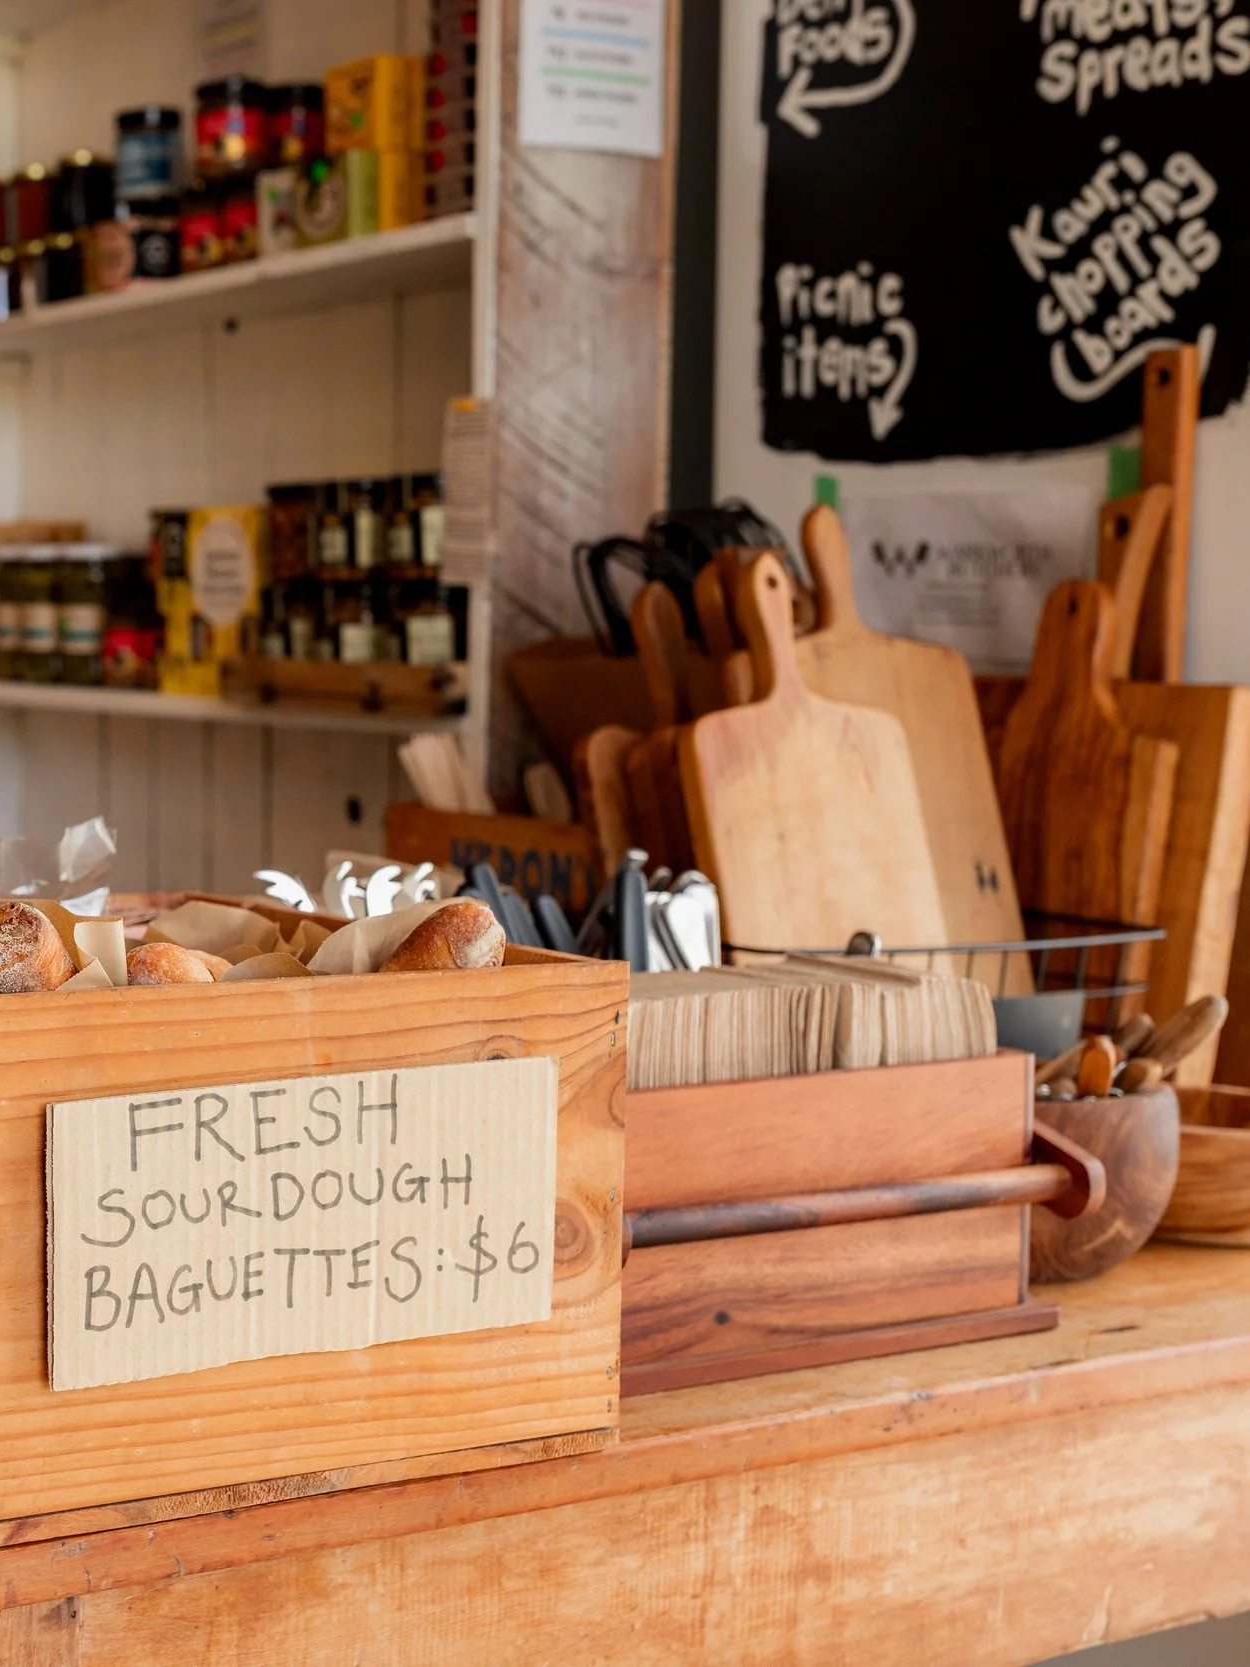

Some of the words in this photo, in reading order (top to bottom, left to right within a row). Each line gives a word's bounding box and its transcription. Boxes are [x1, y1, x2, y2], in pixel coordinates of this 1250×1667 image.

[1008, 134, 1149, 283] Kauri
[1036, 150, 1218, 335] chopping
[781, 322, 897, 403] items
[1071, 216, 1222, 376] boards
[128, 1073, 398, 1172] FRESH
